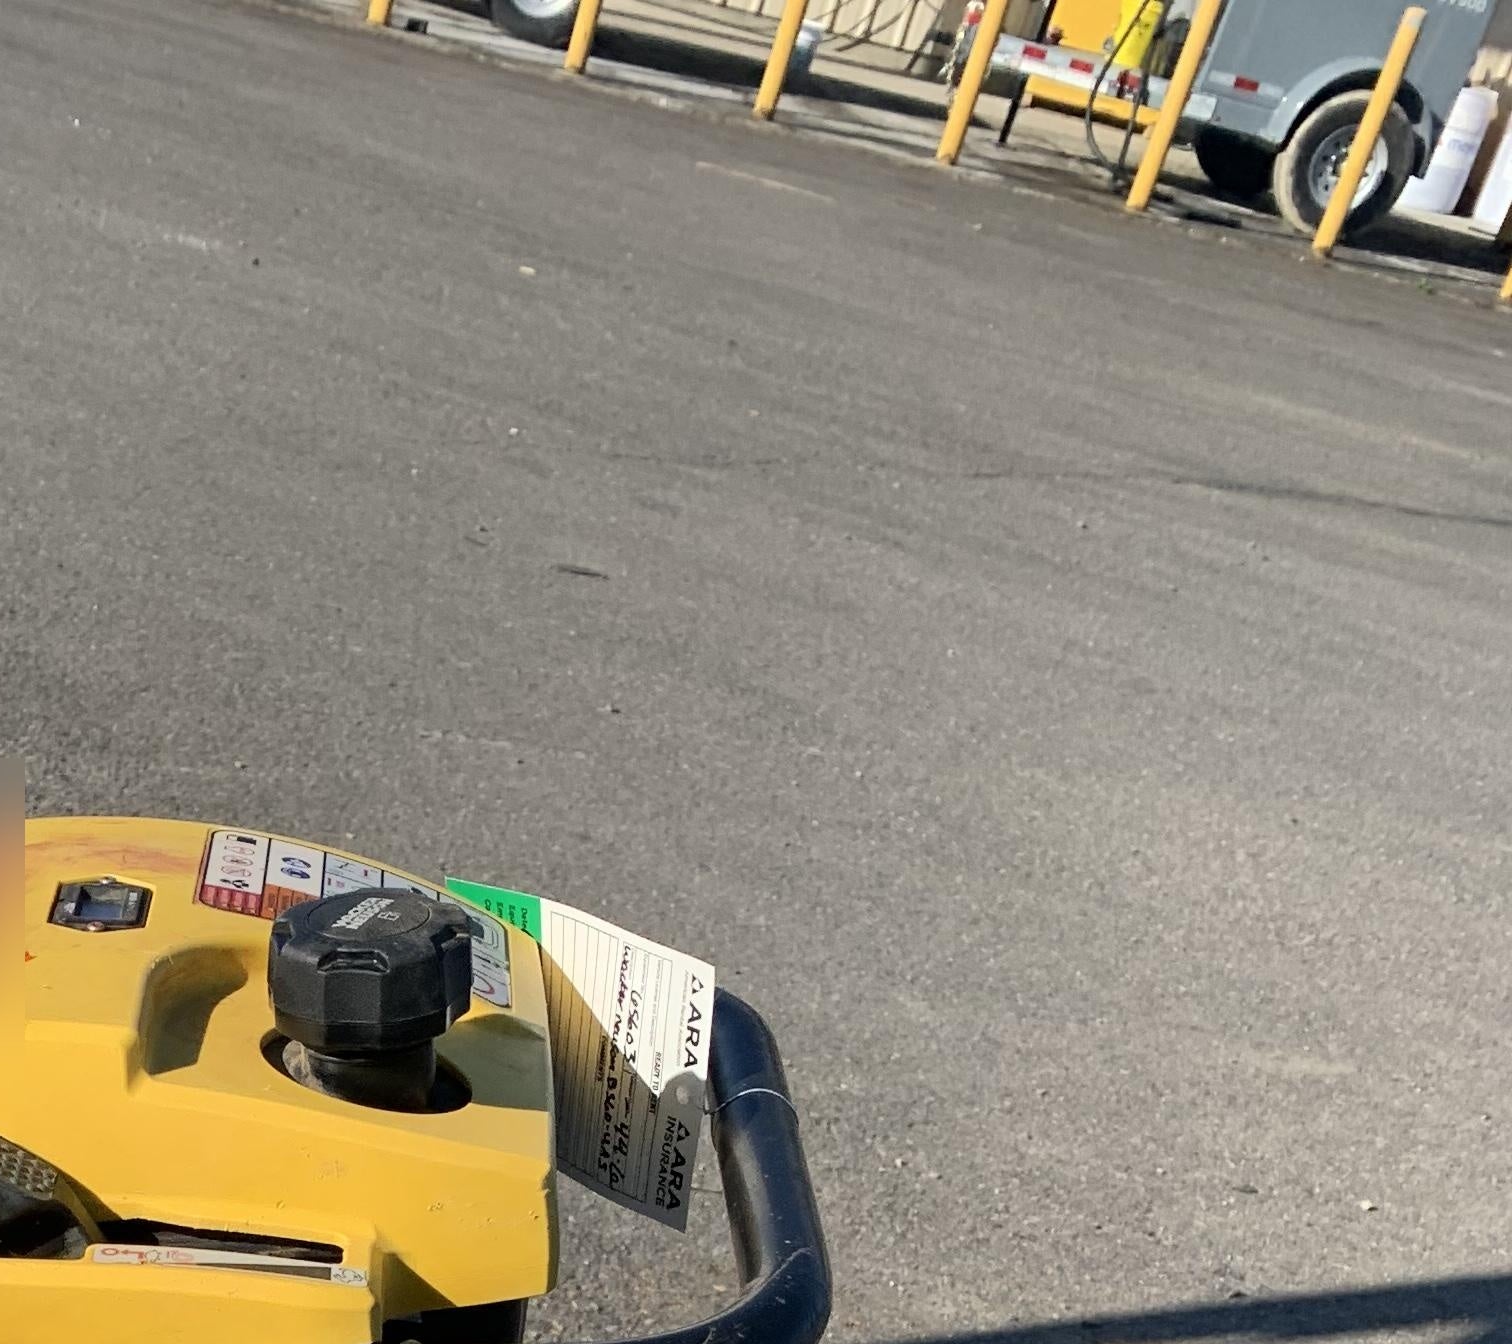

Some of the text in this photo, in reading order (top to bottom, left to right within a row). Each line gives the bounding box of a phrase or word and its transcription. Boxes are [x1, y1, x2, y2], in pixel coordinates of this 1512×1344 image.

[652, 1051, 662, 1078] READY
[684, 1001, 702, 1068] ARA
[656, 1115, 676, 1208] INSURANCE
[667, 1146, 686, 1210] ARA
